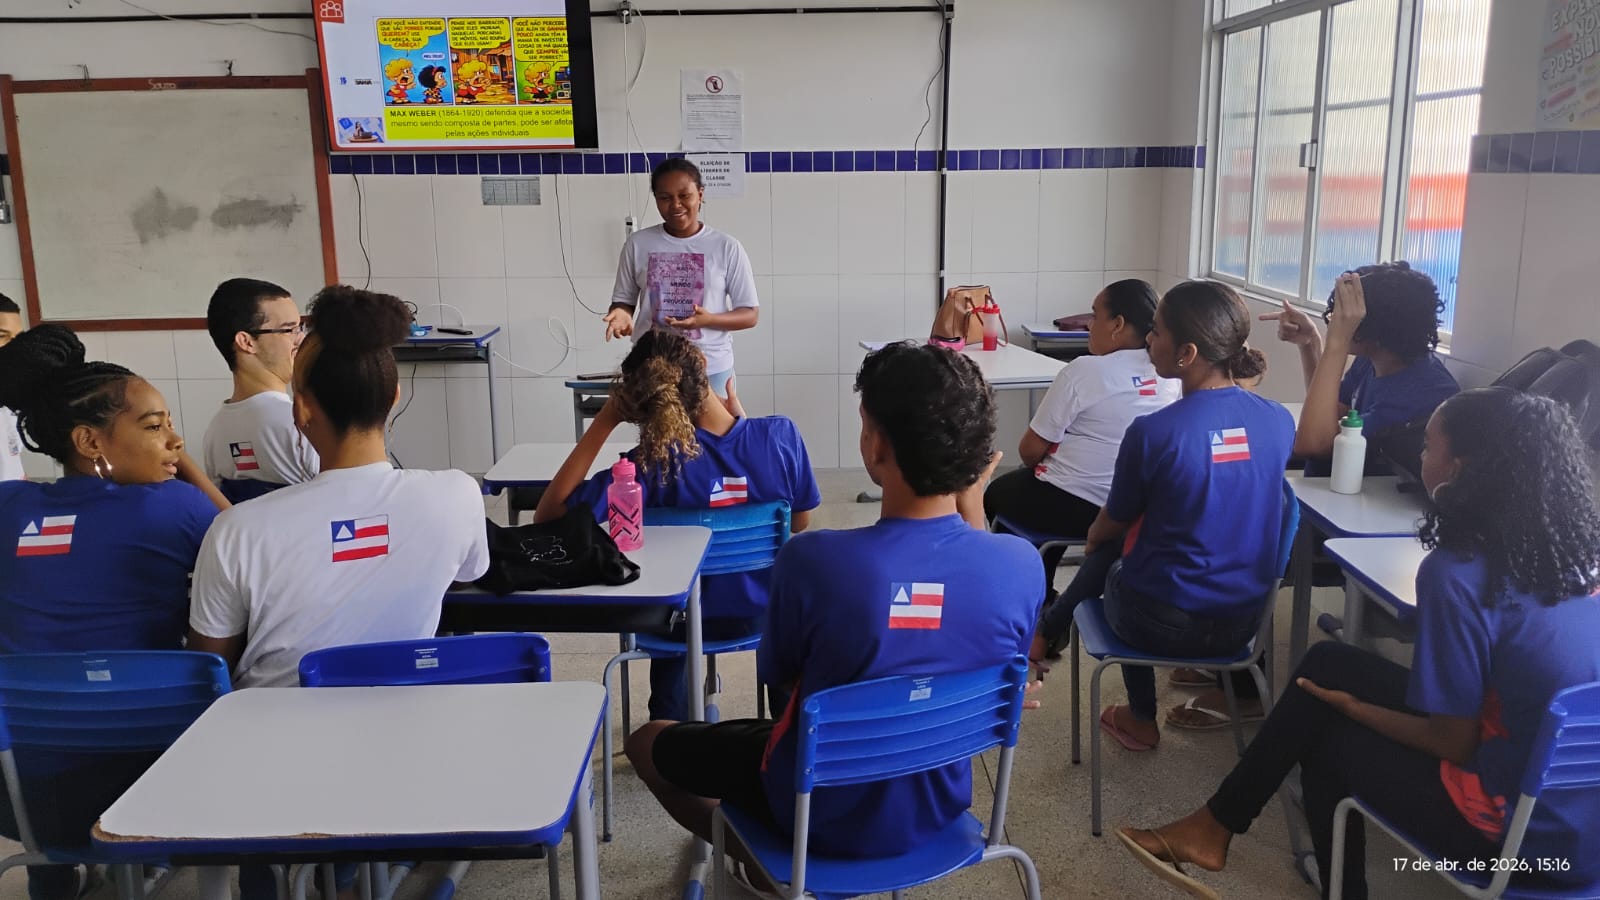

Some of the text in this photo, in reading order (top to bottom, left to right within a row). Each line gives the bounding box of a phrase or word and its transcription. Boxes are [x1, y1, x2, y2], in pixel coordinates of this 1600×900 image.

[1552, 0, 1600, 32] EXPE
[438, 109, 484, 118] (1864-1920)
[485, 108, 517, 116] defendia
[518, 109, 533, 117] que
[444, 119, 480, 128] composta
[482, 119, 491, 127] de
[520, 119, 539, 127] pode
[445, 130, 465, 138] pelas
[467, 129, 490, 138] ações
